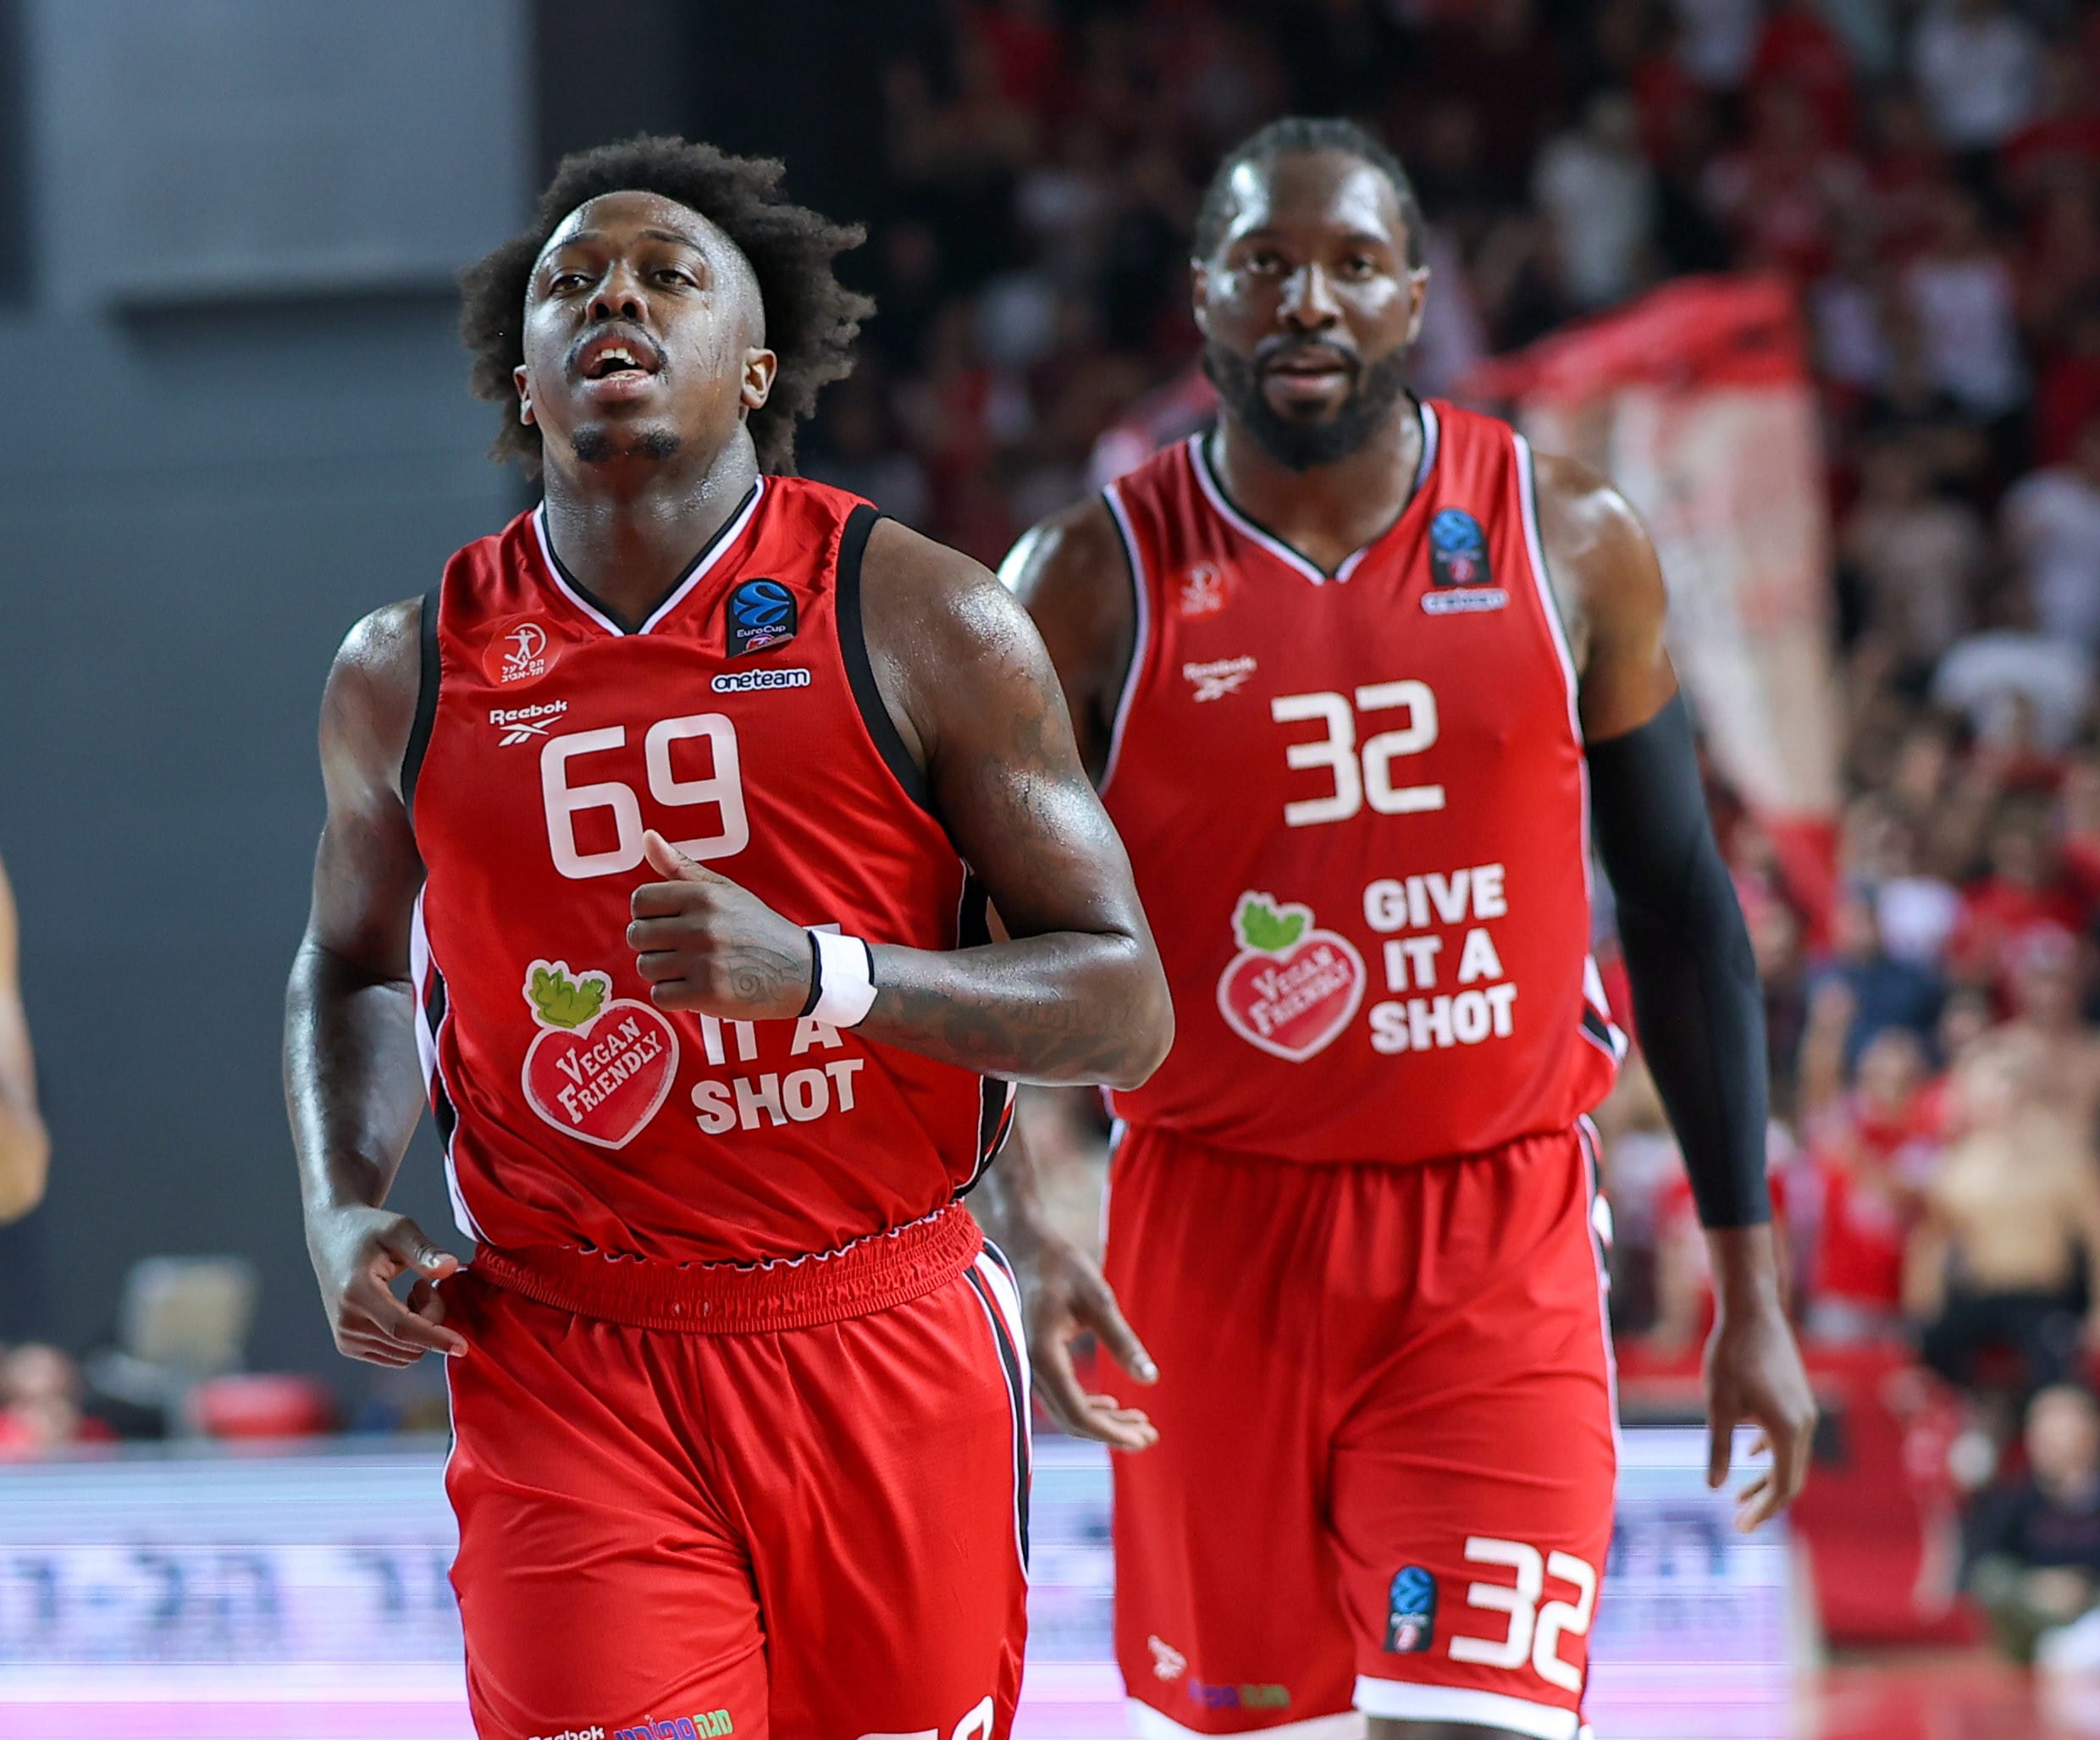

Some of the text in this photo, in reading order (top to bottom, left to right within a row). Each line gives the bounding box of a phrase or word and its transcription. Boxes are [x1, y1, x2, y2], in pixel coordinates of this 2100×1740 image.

[737, 625, 787, 638] EuroCup
[489, 699, 568, 726] Reebok
[712, 669, 810, 692] oneteam
[1271, 679, 1445, 827] 32
[540, 713, 749, 879] 69
[1362, 863, 1508, 933] GIVE
[1383, 927, 1503, 993] IT A
[555, 1016, 641, 1085] VEGAN
[699, 1013, 843, 1066] IT A
[1368, 982, 1519, 1056] SHOT
[556, 1030, 663, 1124] FRIENDLY
[691, 1058, 864, 1135] SHOT
[1448, 1536, 1597, 1693] 32
